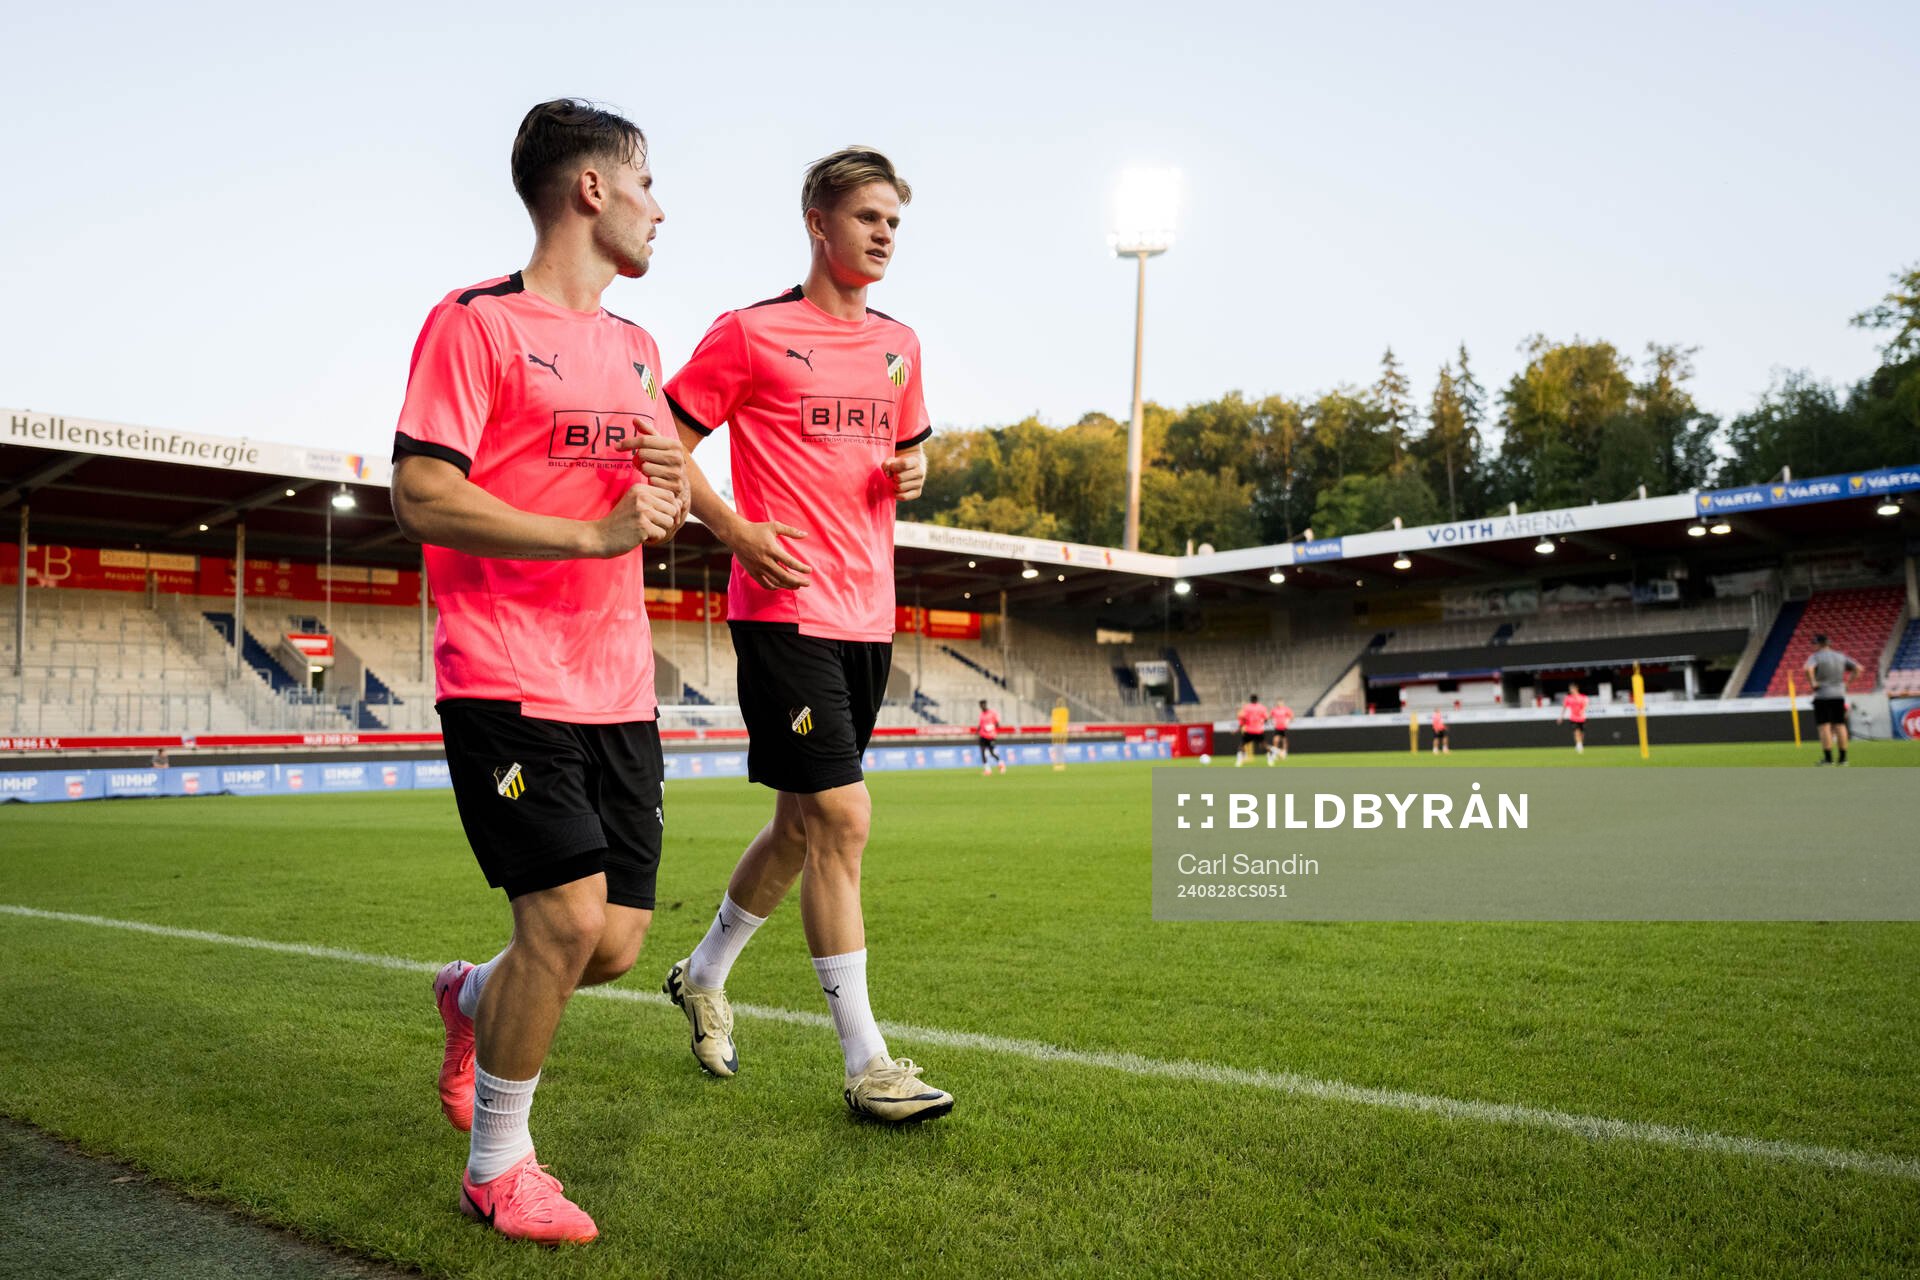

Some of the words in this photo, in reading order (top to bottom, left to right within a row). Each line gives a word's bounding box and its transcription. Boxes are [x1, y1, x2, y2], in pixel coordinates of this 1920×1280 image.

[10, 415, 259, 467] HellensteinEnergie
[1867, 472, 1920, 489] VARTA
[1788, 482, 1840, 499] VARTA
[1714, 491, 1763, 508] VARTA
[1428, 522, 1493, 543] VOITH
[1502, 513, 1576, 535] ARENA
[4, 777, 38, 791] MHP
[126, 773, 158, 787] MHP
